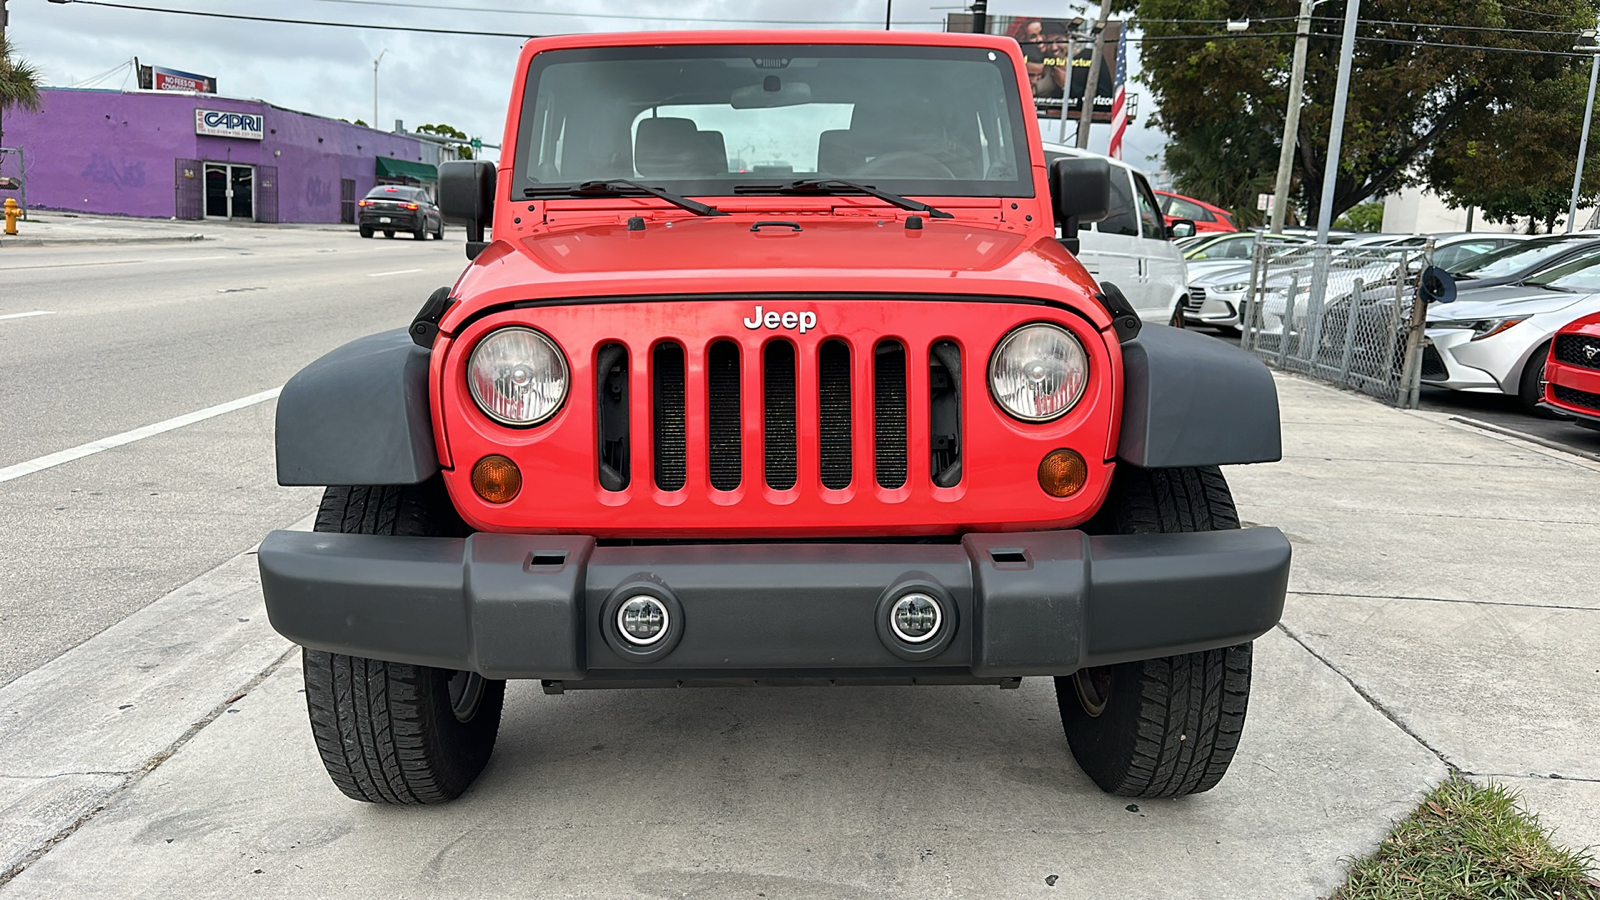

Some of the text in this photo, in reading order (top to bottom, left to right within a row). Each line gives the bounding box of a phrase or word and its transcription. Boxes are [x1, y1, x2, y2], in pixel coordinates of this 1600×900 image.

[165, 76, 196, 88] NO FEES OR
[204, 112, 261, 132] CAPRI
[743, 305, 817, 334] Jeep
